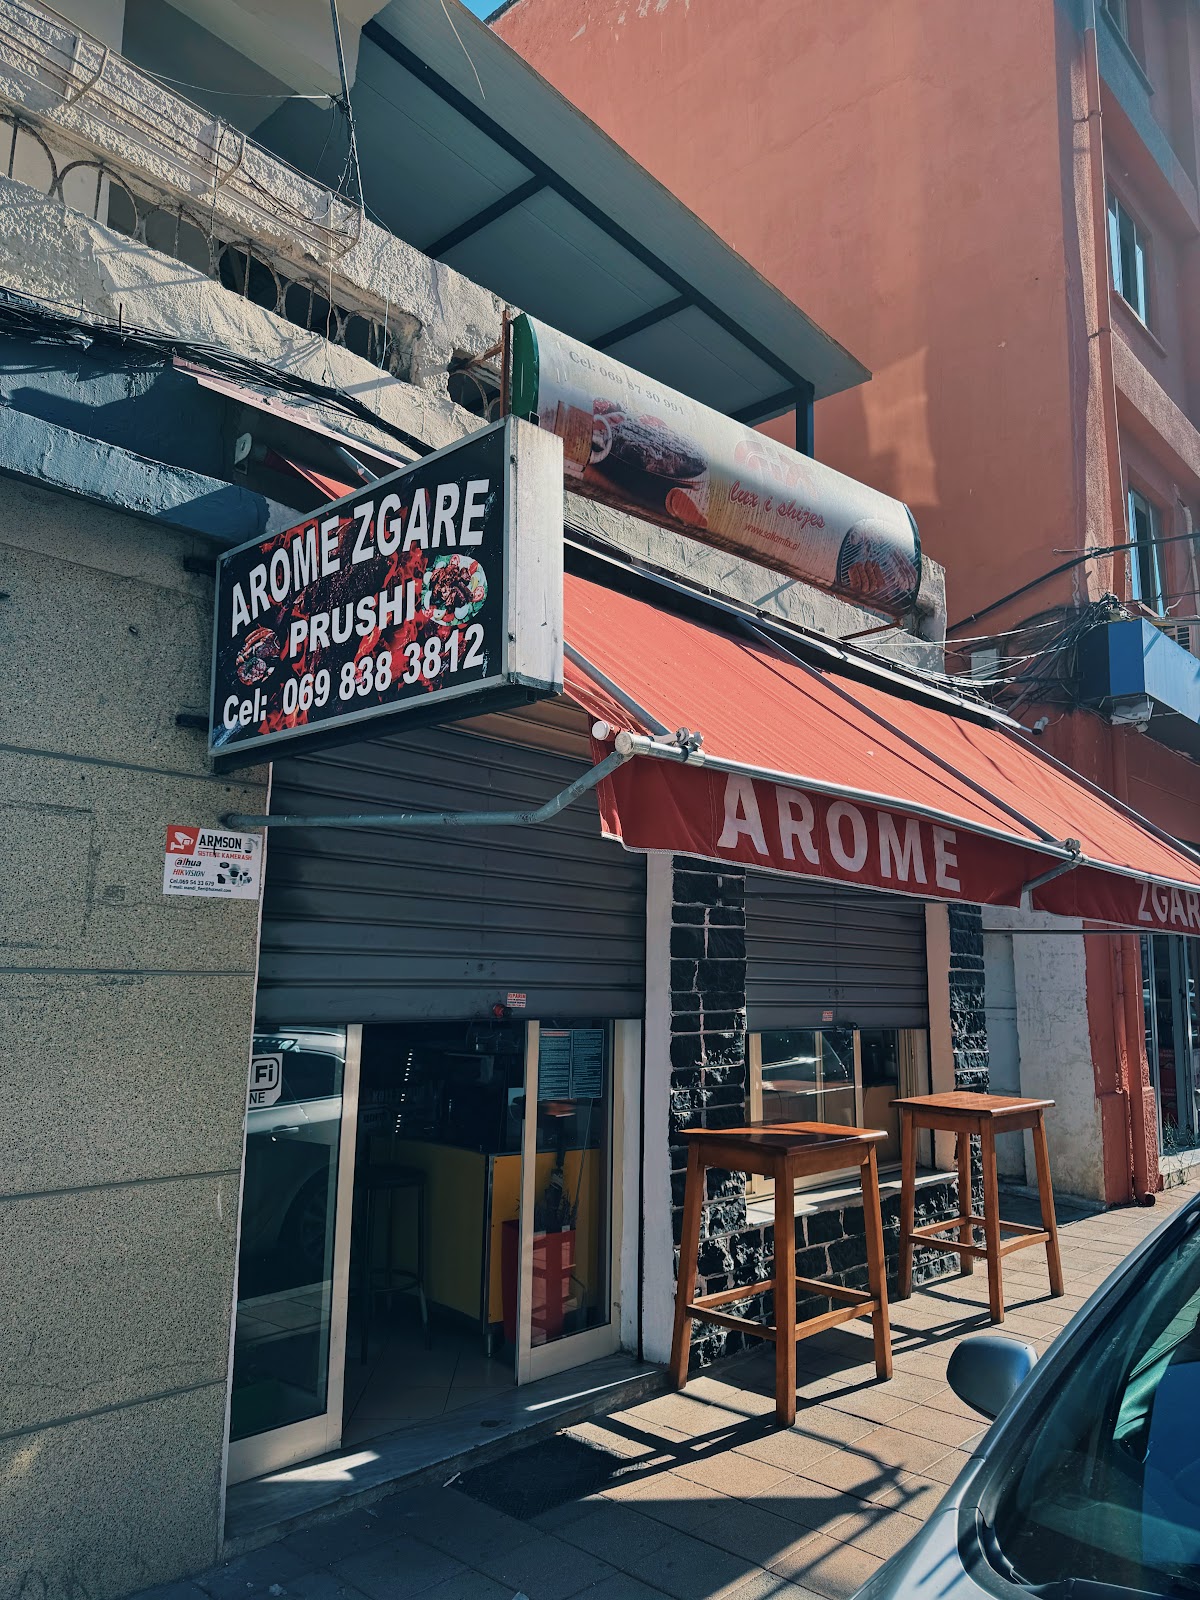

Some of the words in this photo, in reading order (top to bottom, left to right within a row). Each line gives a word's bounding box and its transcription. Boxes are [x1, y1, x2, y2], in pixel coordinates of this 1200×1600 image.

[569, 351, 595, 371] Cel:
[600, 367, 622, 384] 069
[664, 398, 684, 415] 991
[730, 480, 759, 507] lux
[764, 496, 773, 512] i
[778, 499, 825, 530] shijes
[231, 514, 341, 638] AROME
[352, 478, 490, 565] ZGARE
[289, 580, 416, 658] PRUSHI
[223, 688, 267, 730] Cel:
[282, 667, 331, 715] 069
[339, 650, 392, 701] 838
[402, 622, 485, 685] 3812
[199, 835, 241, 849] ARMSON
[717, 772, 961, 893] AROME
[173, 869, 205, 877] HIKVISION
